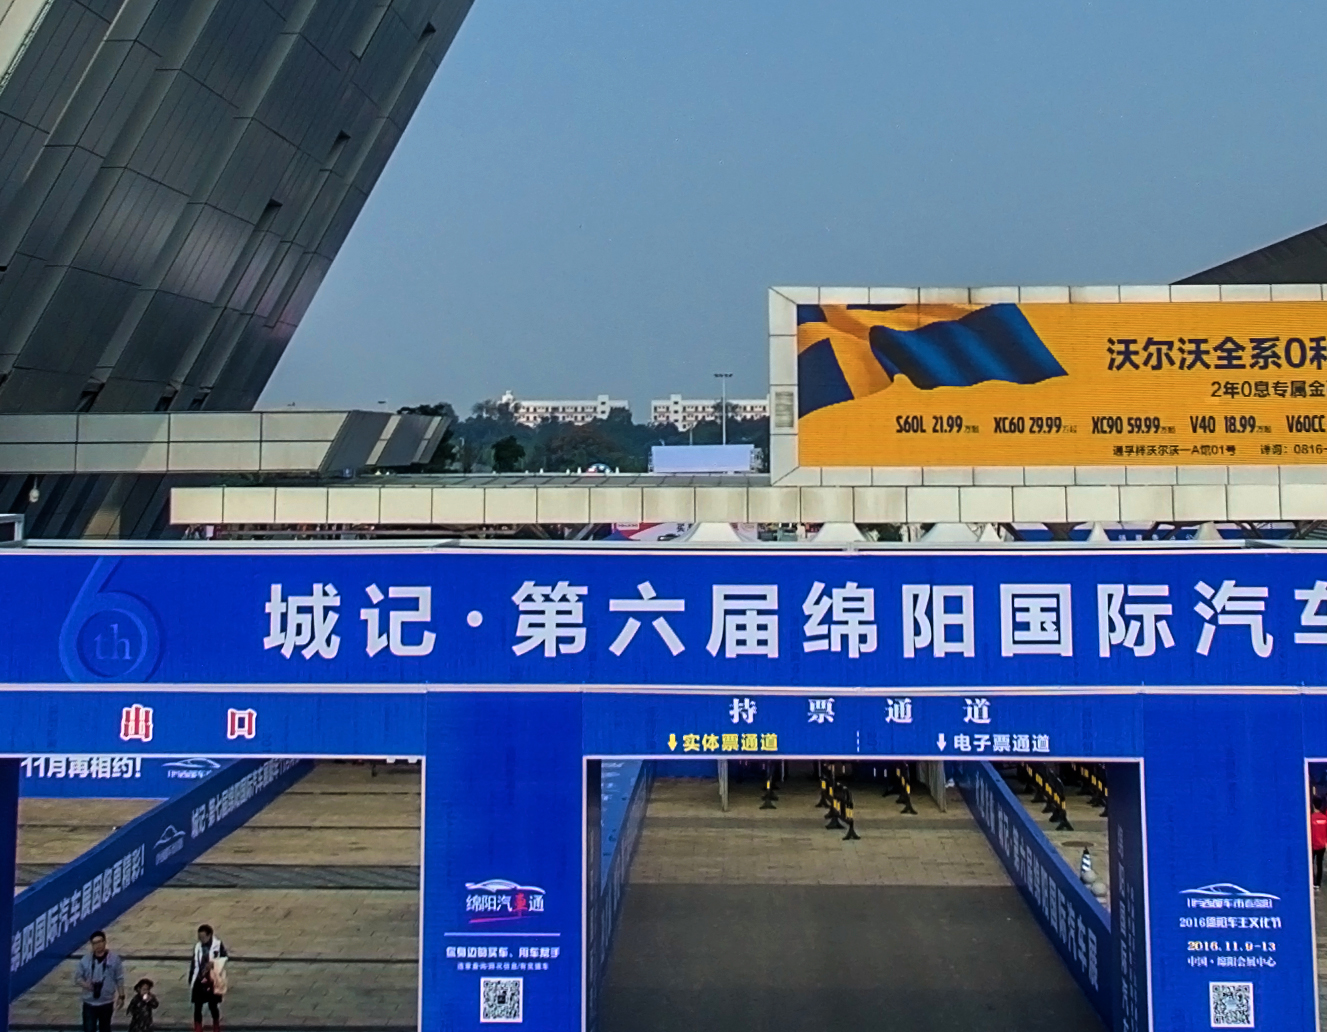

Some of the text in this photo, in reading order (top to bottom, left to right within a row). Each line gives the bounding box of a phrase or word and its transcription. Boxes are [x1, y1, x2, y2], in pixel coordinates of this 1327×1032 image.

[895, 415, 926, 434] S60L
[993, 416, 1024, 434] XC60
[1091, 416, 1122, 434] XC90
[1190, 416, 1216, 434] V40
[1286, 415, 1325, 434] V60CC
[729, 698, 991, 724] 持票通道
[120, 703, 256, 742] 出口
[683, 733, 778, 751] 实体票通道
[954, 734, 1050, 752] 电子票通道
[1187, 940, 1276, 952] 2016.11.9-13
